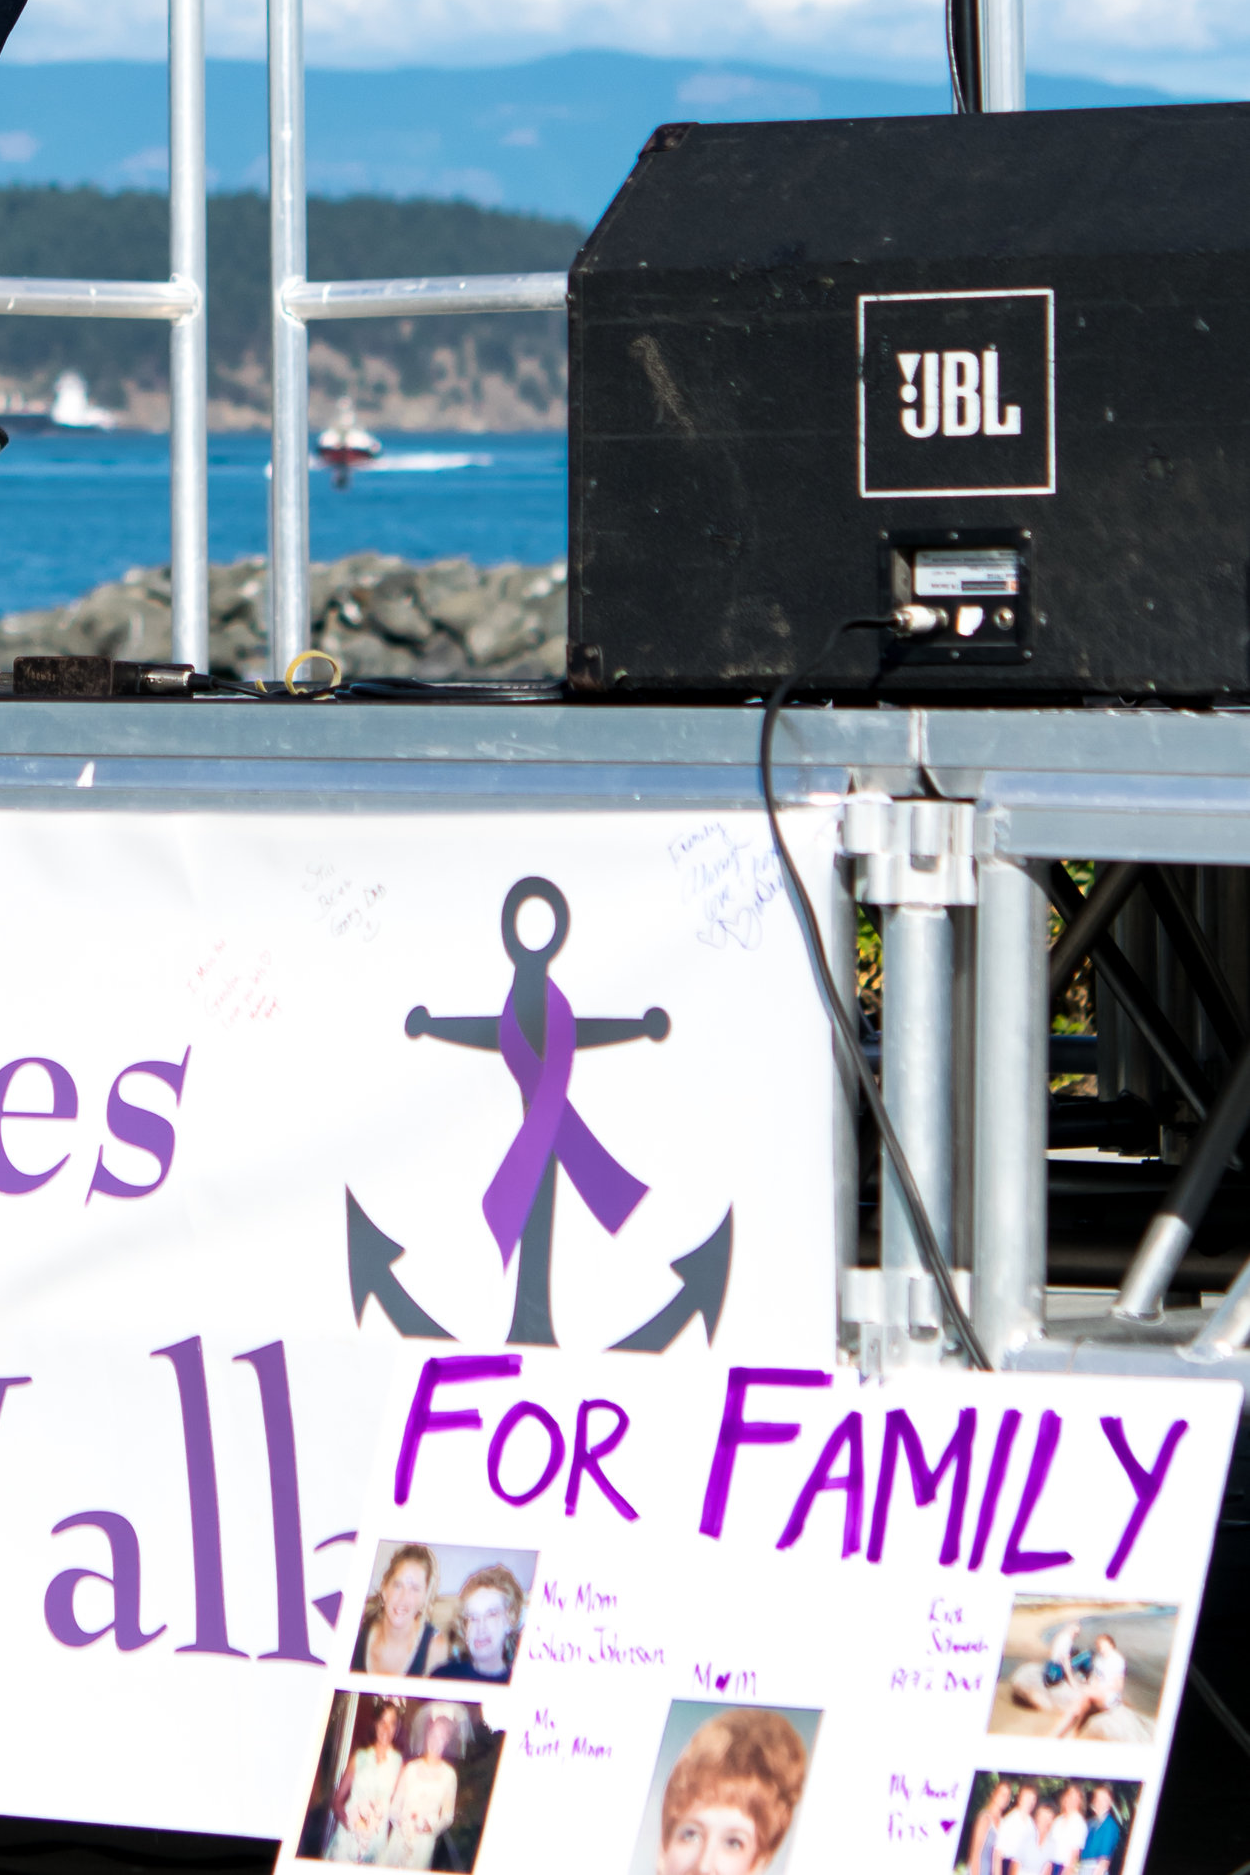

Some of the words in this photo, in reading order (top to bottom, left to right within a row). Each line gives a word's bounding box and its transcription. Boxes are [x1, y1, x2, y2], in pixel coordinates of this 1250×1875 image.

[897, 350, 1022, 439] JBL
[394, 1353, 640, 1523] FOR
[698, 1366, 1190, 1581] FAMILY
